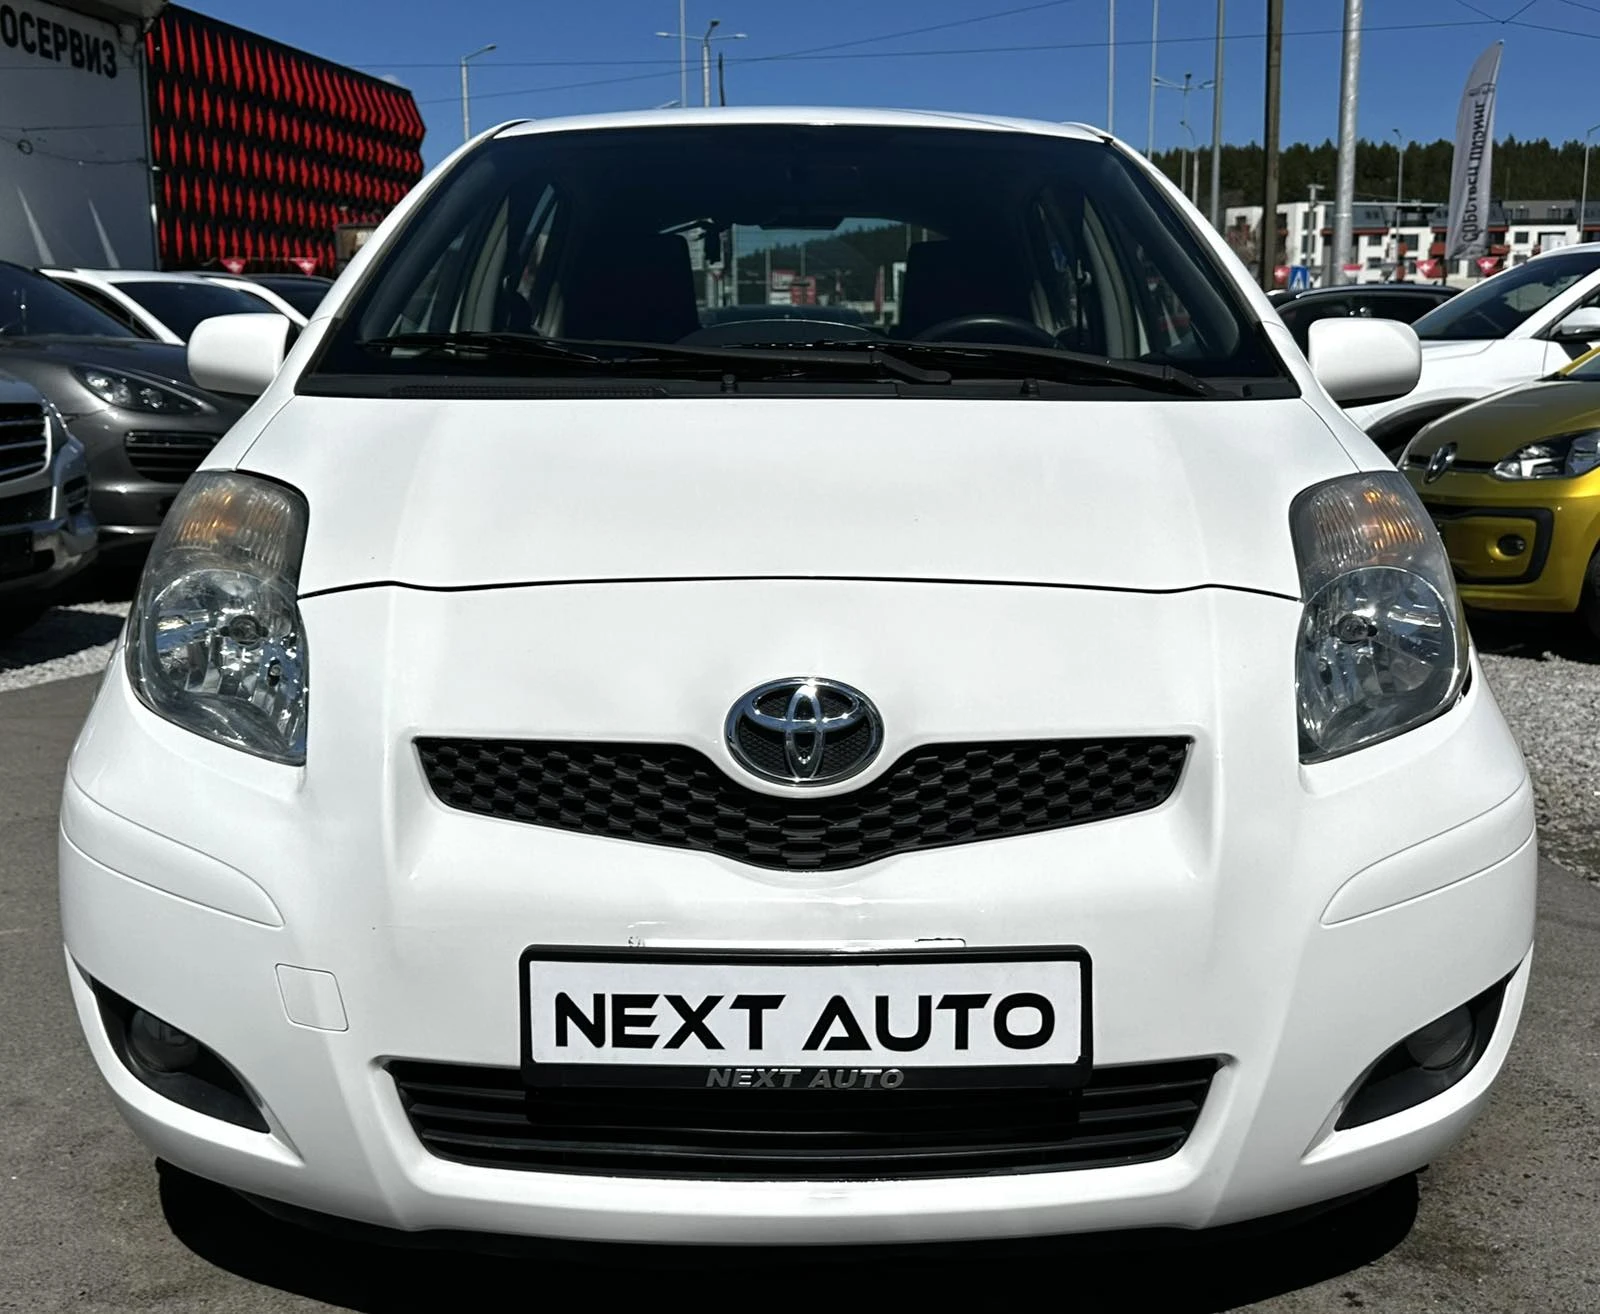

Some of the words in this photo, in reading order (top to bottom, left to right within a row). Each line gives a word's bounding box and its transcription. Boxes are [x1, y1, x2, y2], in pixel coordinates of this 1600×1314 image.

[0, 4, 117, 79] ОСЕРВИЗ
[555, 992, 786, 1050] NEXT
[802, 992, 1055, 1052] AUTO
[706, 1068, 801, 1088] NEXT
[808, 1068, 905, 1089] AUTO
